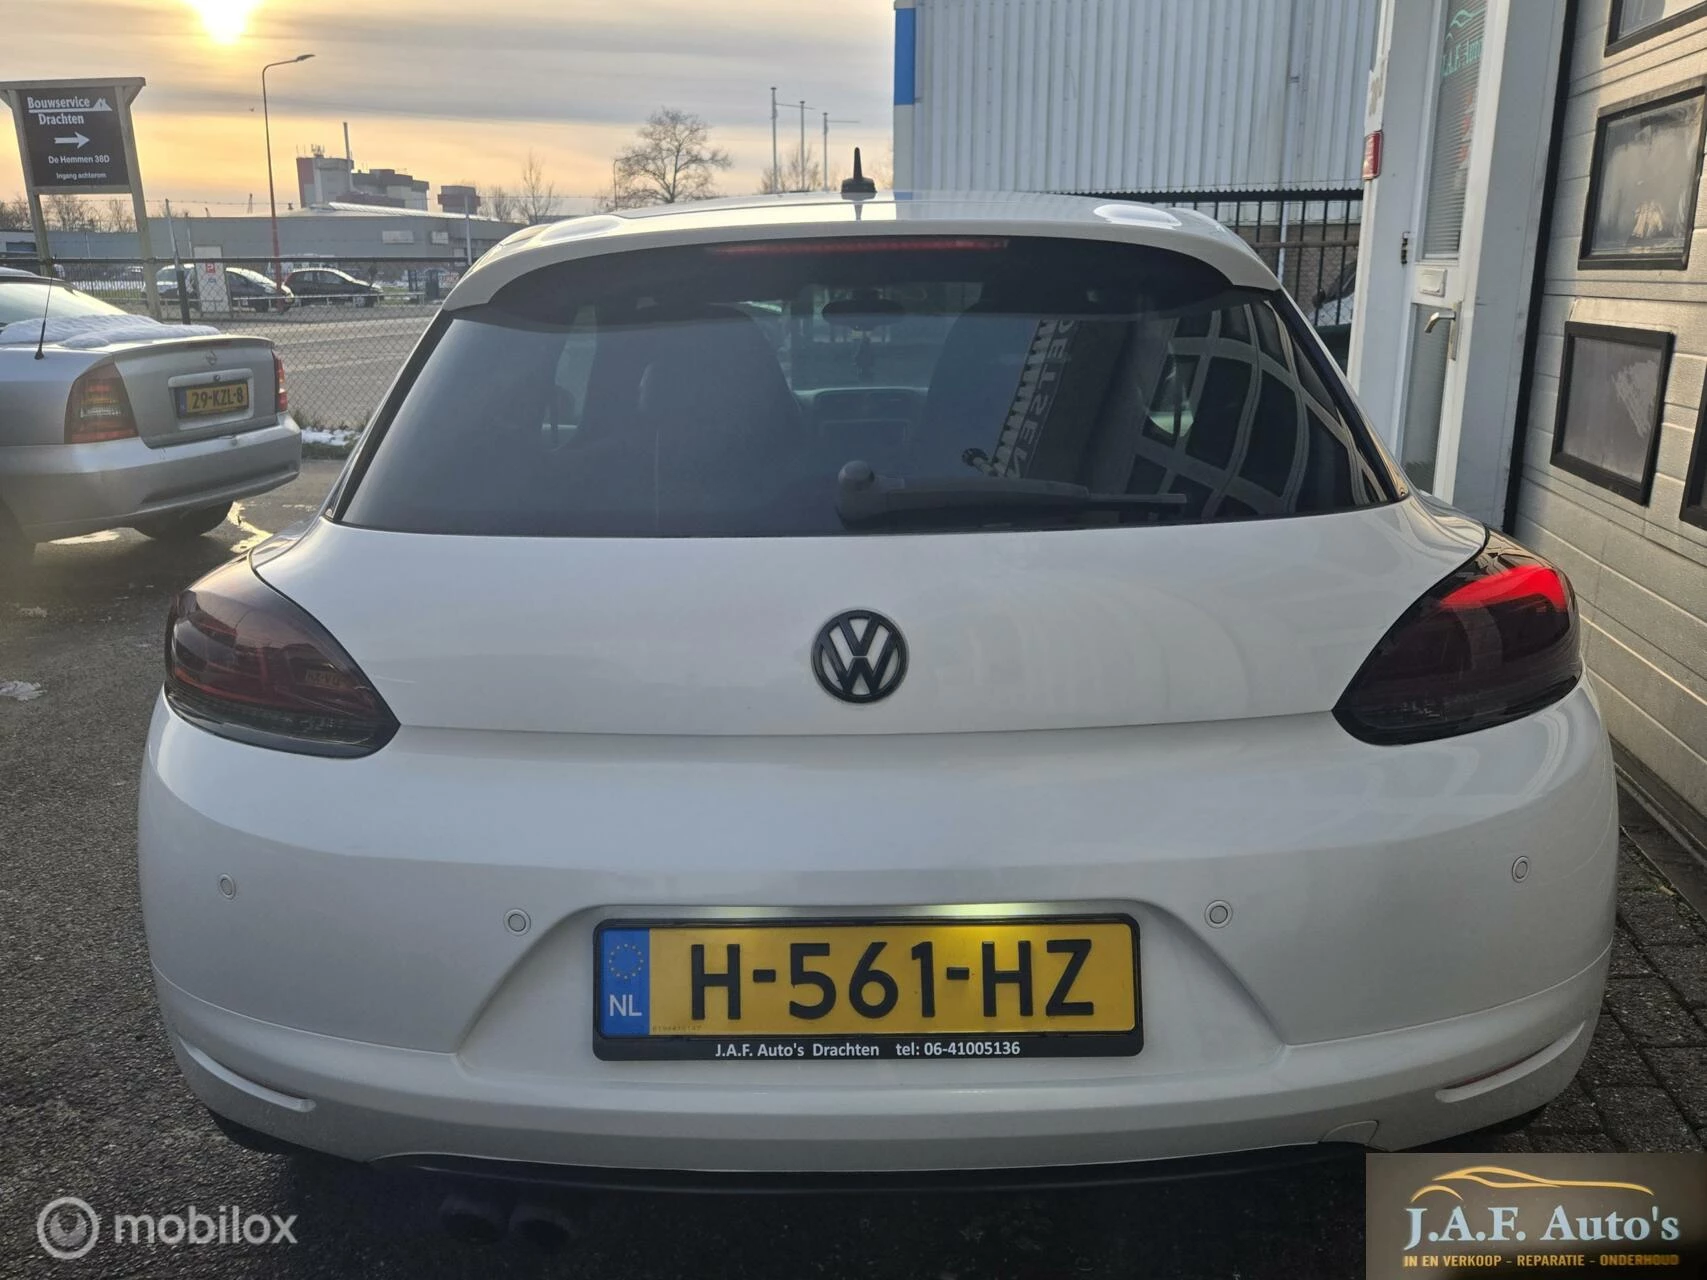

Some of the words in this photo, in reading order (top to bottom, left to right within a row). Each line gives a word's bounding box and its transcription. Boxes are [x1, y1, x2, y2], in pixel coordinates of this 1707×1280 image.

[27, 96, 91, 109] Bouwservice
[38, 113, 85, 125] Drachten
[48, 155, 59, 164] De
[60, 154, 94, 164] Hemmen
[56, 172, 77, 180] Ingang
[191, 387, 244, 409] 29-KZL-8
[691, 939, 1094, 1021] H-561-HZ
[609, 994, 642, 1017] NL
[715, 1043, 753, 1057] J.A.F.
[757, 1042, 805, 1057] Auto's
[812, 1042, 880, 1057] Drachten
[896, 1042, 920, 1056] tel:
[924, 1041, 1021, 1056] 06-41005136
